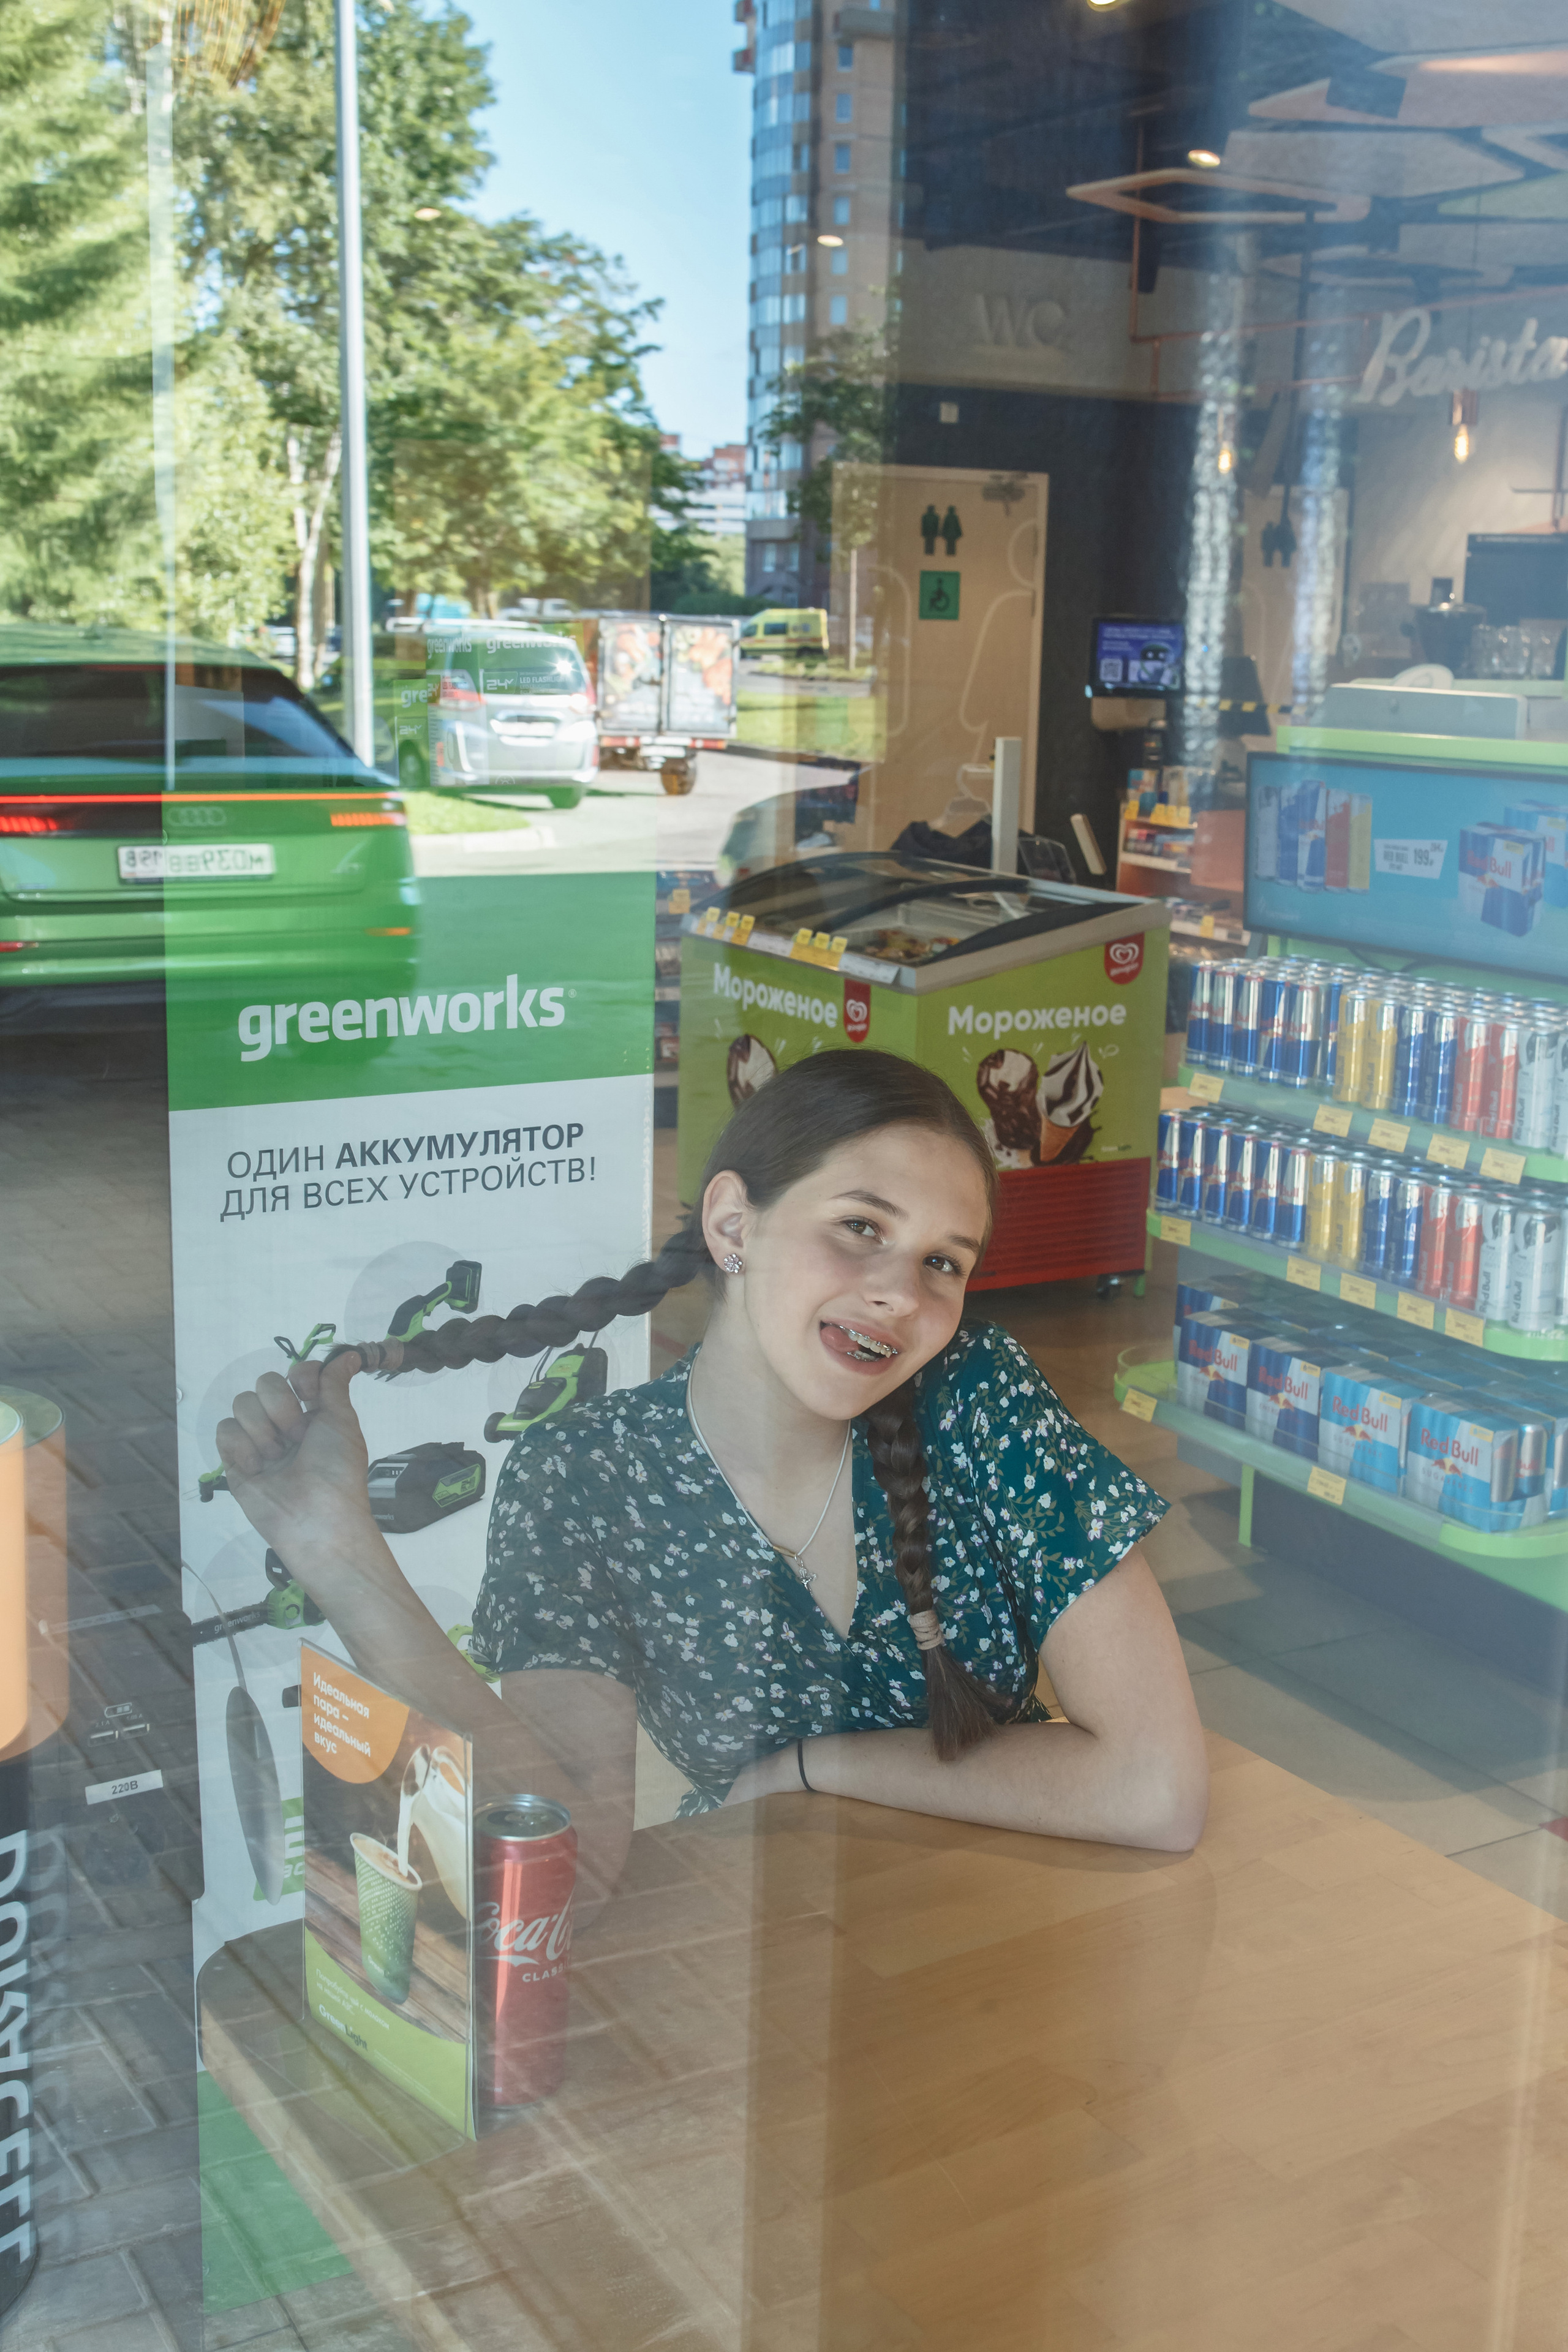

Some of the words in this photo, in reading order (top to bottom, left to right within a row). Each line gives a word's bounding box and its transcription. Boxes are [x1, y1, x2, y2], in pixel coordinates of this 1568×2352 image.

[974, 292, 1067, 349] WC
[1351, 308, 1568, 407] Barista
[714, 962, 838, 1028] Мороженое
[238, 973, 566, 1062] greenworks
[948, 1003, 1127, 1040] Мороженое
[227, 1145, 325, 1182] ОДИН
[335, 1123, 584, 1169] АККУМУЛЯТОР
[220, 1186, 290, 1222] ДЛЯ
[303, 1176, 388, 1210] ВСЕХ
[398, 1156, 597, 1200] УСТРОЙСТВ!
[1188, 1340, 1213, 1362] Red
[1214, 1349, 1238, 1371] Bull
[1258, 1366, 1283, 1390] Red
[1284, 1376, 1308, 1400] Bull
[1332, 1396, 1360, 1421] Red
[1361, 1408, 1388, 1433] Bull
[1421, 1428, 1450, 1454] Red
[1450, 1441, 1479, 1467] Bull
[214, 1611, 261, 1634] grenworks
[313, 1672, 370, 1719] Идеальная
[313, 1694, 339, 1719] пара
[314, 1713, 371, 1757] идеальный
[314, 1732, 337, 1754] вкус
[318, 2003, 368, 2051] GreenLight
